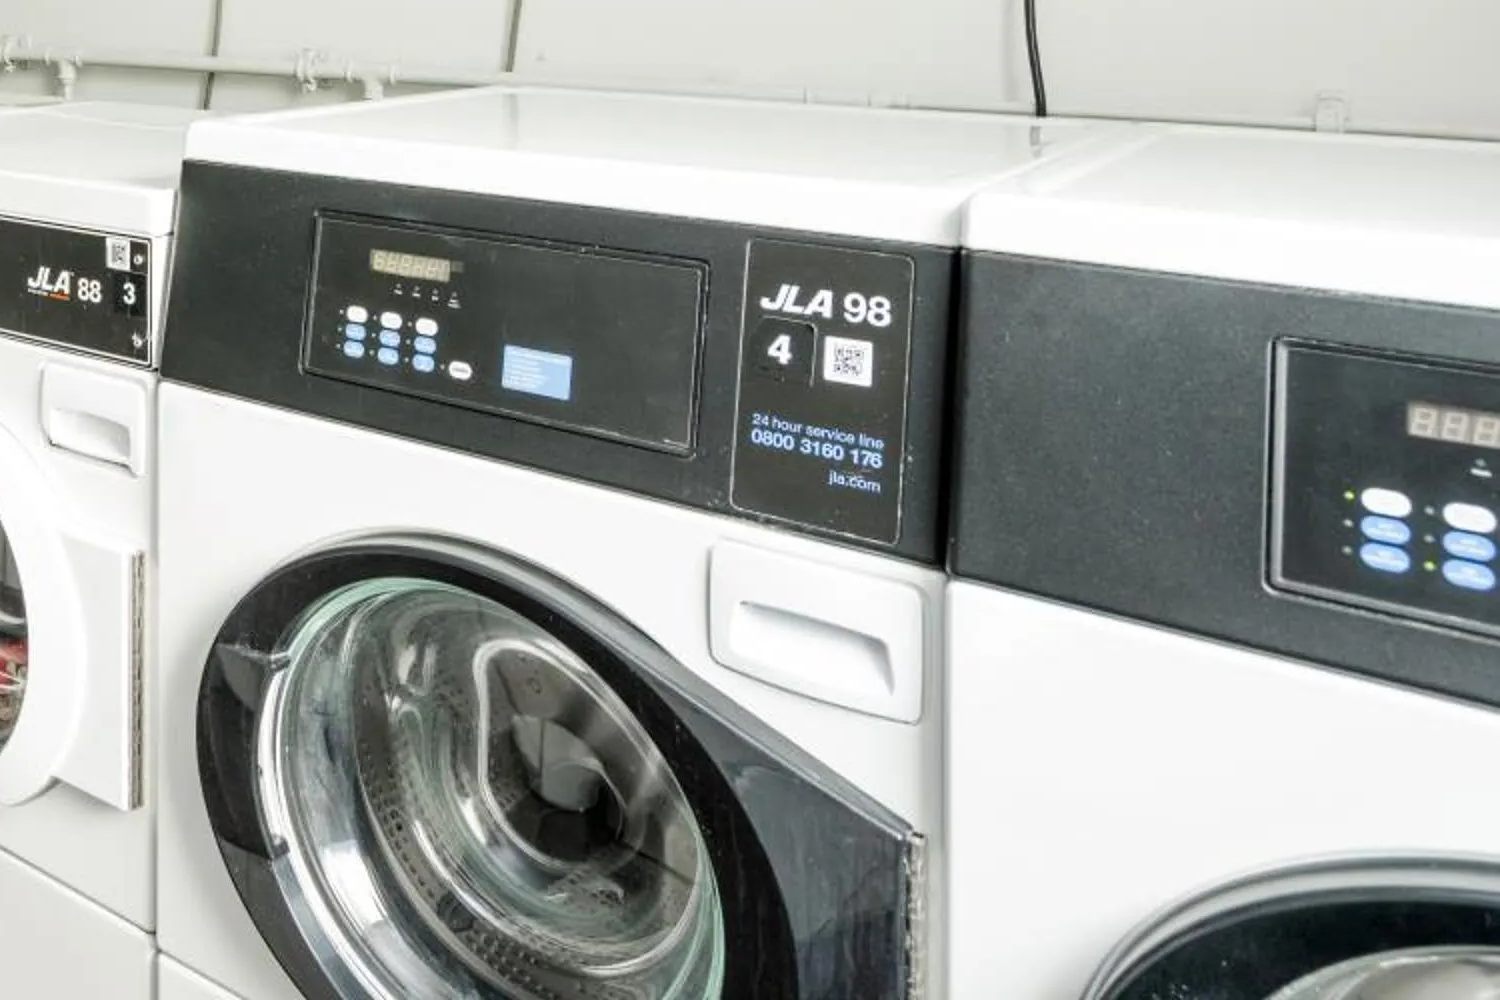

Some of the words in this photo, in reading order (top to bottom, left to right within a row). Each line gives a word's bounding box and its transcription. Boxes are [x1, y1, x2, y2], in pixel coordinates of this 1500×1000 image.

[27, 265, 71, 294] JLA
[77, 277, 102, 303] 88
[123, 281, 136, 305] 3
[760, 284, 834, 318] JLA
[843, 293, 892, 327] 98
[767, 334, 793, 365] 4
[751, 428, 795, 450] 0800
[800, 438, 845, 461] 3160
[752, 412, 769, 427] 24
[771, 416, 802, 433] hour
[805, 425, 855, 444] service
[859, 432, 884, 450] line
[828, 469, 882, 494] jla.com
